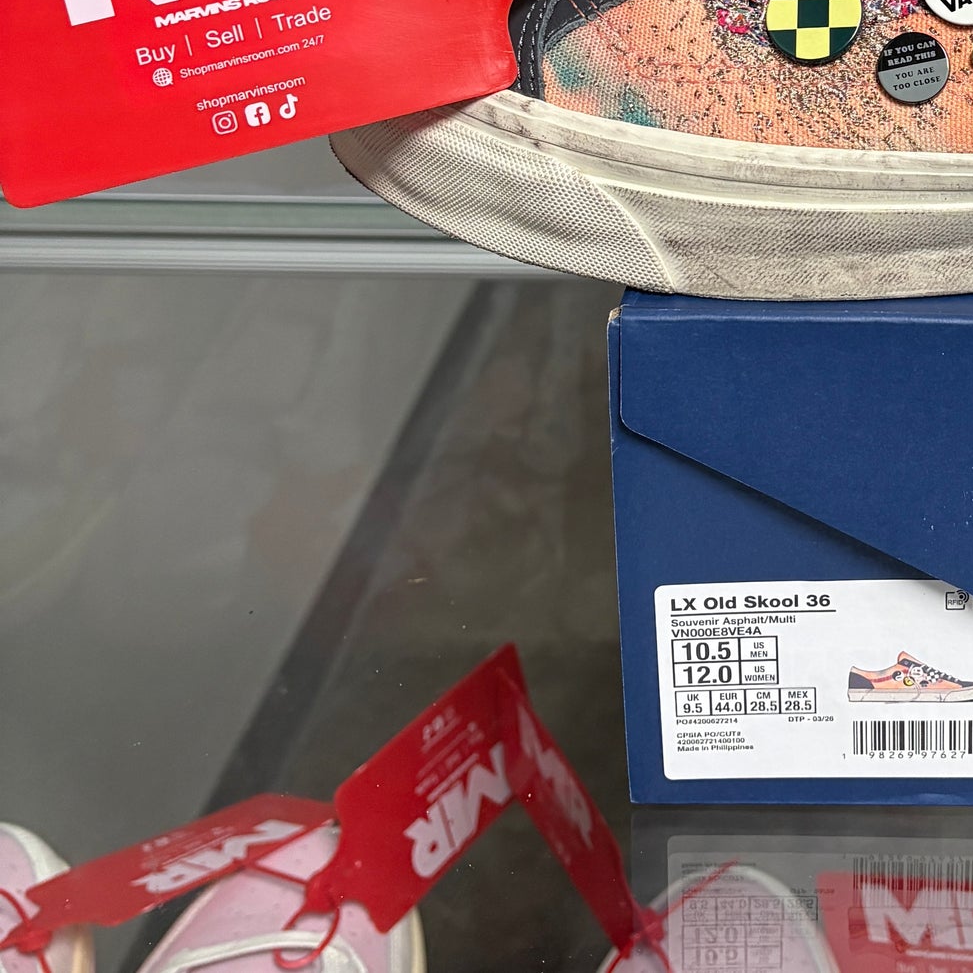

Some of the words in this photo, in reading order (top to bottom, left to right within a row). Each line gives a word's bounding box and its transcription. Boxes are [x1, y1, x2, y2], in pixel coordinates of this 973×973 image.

[136, 44, 175, 66] Buy
[205, 24, 244, 48] Sell
[272, 6, 331, 31] Trade
[884, 48, 893, 56] IF
[895, 44, 914, 54] YOU
[916, 40, 936, 49] CAN
[180, 41, 300, 79] Shopmarvinsroom.com
[302, 35, 325, 49] 24/7
[887, 55, 912, 66] READ
[914, 51, 936, 60] THIS
[895, 71, 914, 80] YOU
[917, 67, 935, 76] ARE
[893, 82, 911, 91] TOO
[913, 76, 941, 87] CLOSE
[197, 76, 306, 111] shopmarvinsroom
[671, 598, 697, 611] LX
[703, 596, 737, 610] Old
[744, 594, 799, 609] Skool
[806, 594, 831, 607] 36
[671, 617, 719, 627] Souvenir
[723, 615, 796, 626] Asphalt/Multi
[671, 626, 762, 638] VN000E8VE4A
[681, 641, 731, 661] 10.5
[683, 665, 732, 684] 12.0
[744, 674, 775, 682] WOMEN
[756, 691, 771, 699] CM
[683, 703, 703, 714] 9.5
[715, 702, 742, 713] 44.0
[750, 701, 777, 712] 28.5
[784, 700, 812, 711] 28.5
[677, 731, 702, 739] CPSIA
